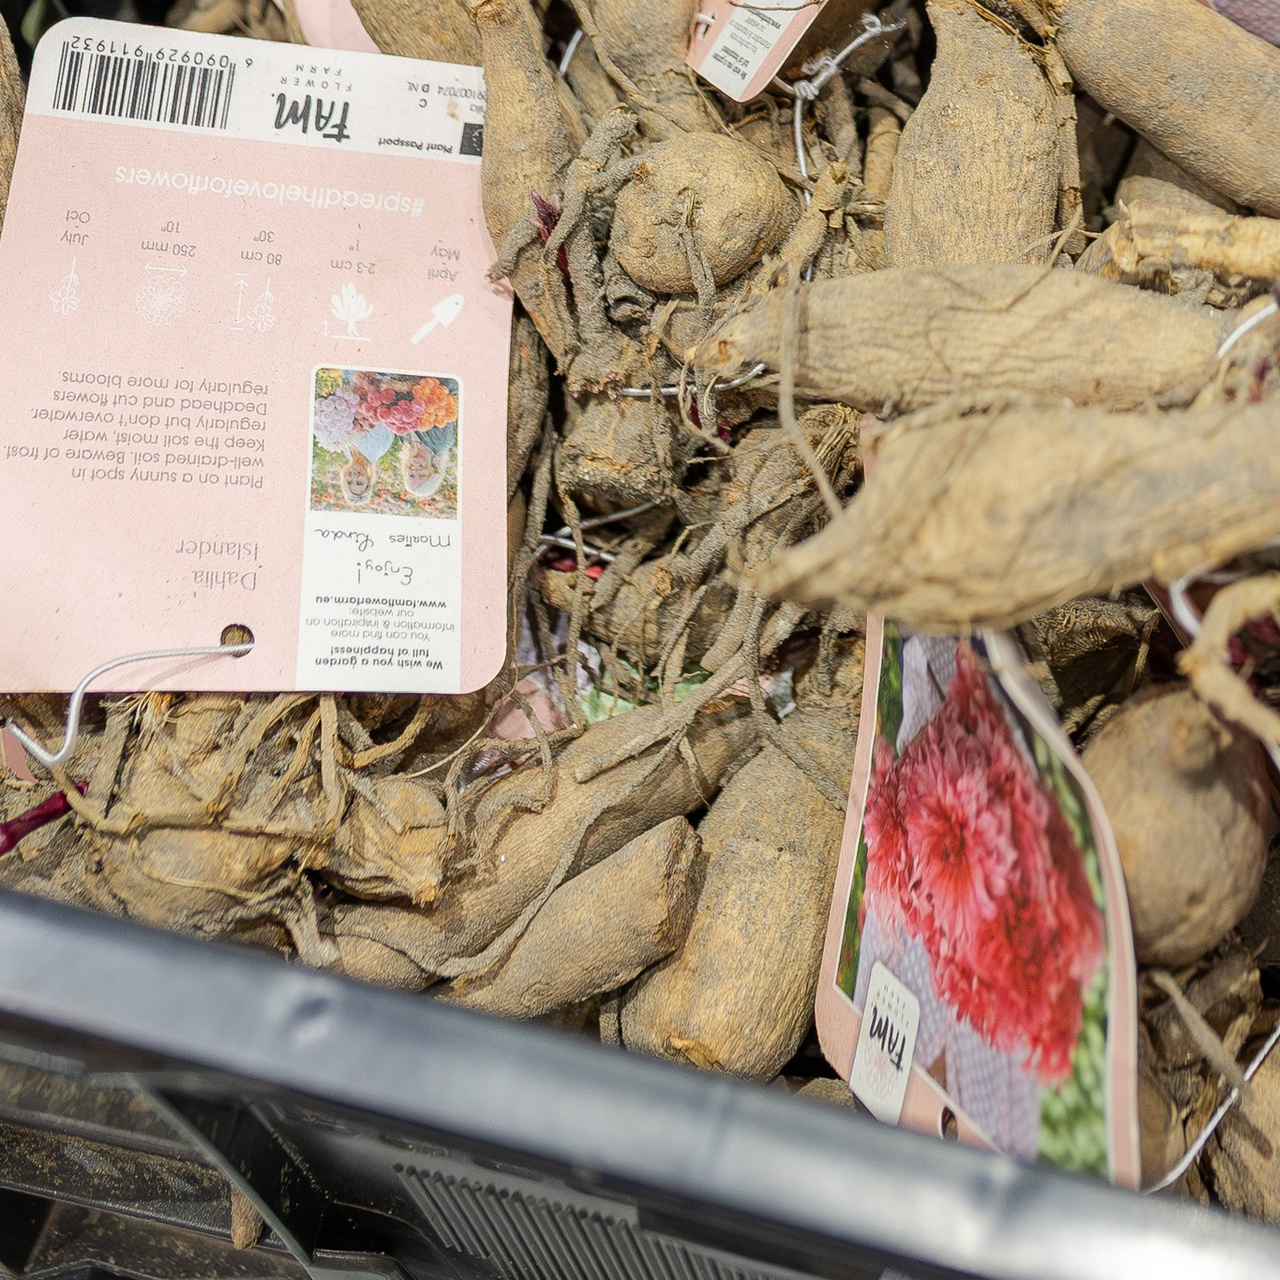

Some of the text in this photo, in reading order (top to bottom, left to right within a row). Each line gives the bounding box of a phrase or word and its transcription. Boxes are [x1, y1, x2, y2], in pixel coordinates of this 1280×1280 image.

[71, 36, 253, 68] 6 090929 911932
[295, 64, 342, 76] FARM
[280, 76, 352, 91] FLOWER
[378, 137, 453, 154] Plant Passport
[113, 165, 426, 218] #spreadtheloveforflowers
[65, 210, 90, 223] Oct
[60, 230, 89, 246] July
[141, 240, 196, 257] 250 mm
[431, 245, 460, 261] May
[241, 251, 282, 265] 80 cm
[330, 260, 376, 274] 2-3 cm
[427, 269, 458, 281] April
[58, 371, 269, 397] regularly for more blooms.
[53, 390, 267, 415] Deadhead and cut flowers
[31, 408, 114, 425] overwater.
[165, 416, 191, 430] but
[196, 416, 266, 433] regularly
[63, 430, 265, 452] Keep the soil moist, water
[3, 445, 264, 469] well-drained soil. Beware of frost.
[72, 467, 264, 489] Plant on a sunny spot in
[175, 540, 259, 561] Islander
[192, 570, 257, 590] Dahlia
[356, 560, 413, 585] Enjoy!
[316, 596, 446, 609] www.famflowerfarm.eu
[306, 618, 454, 632] information & inspiration on
[331, 630, 359, 638] more
[362, 631, 382, 640] find
[411, 632, 430, 642] You
[330, 646, 429, 657] full of happiness!
[315, 656, 357, 666] garden
[373, 657, 393, 666] you
[398, 659, 422, 669] wish
[426, 660, 443, 669] We
